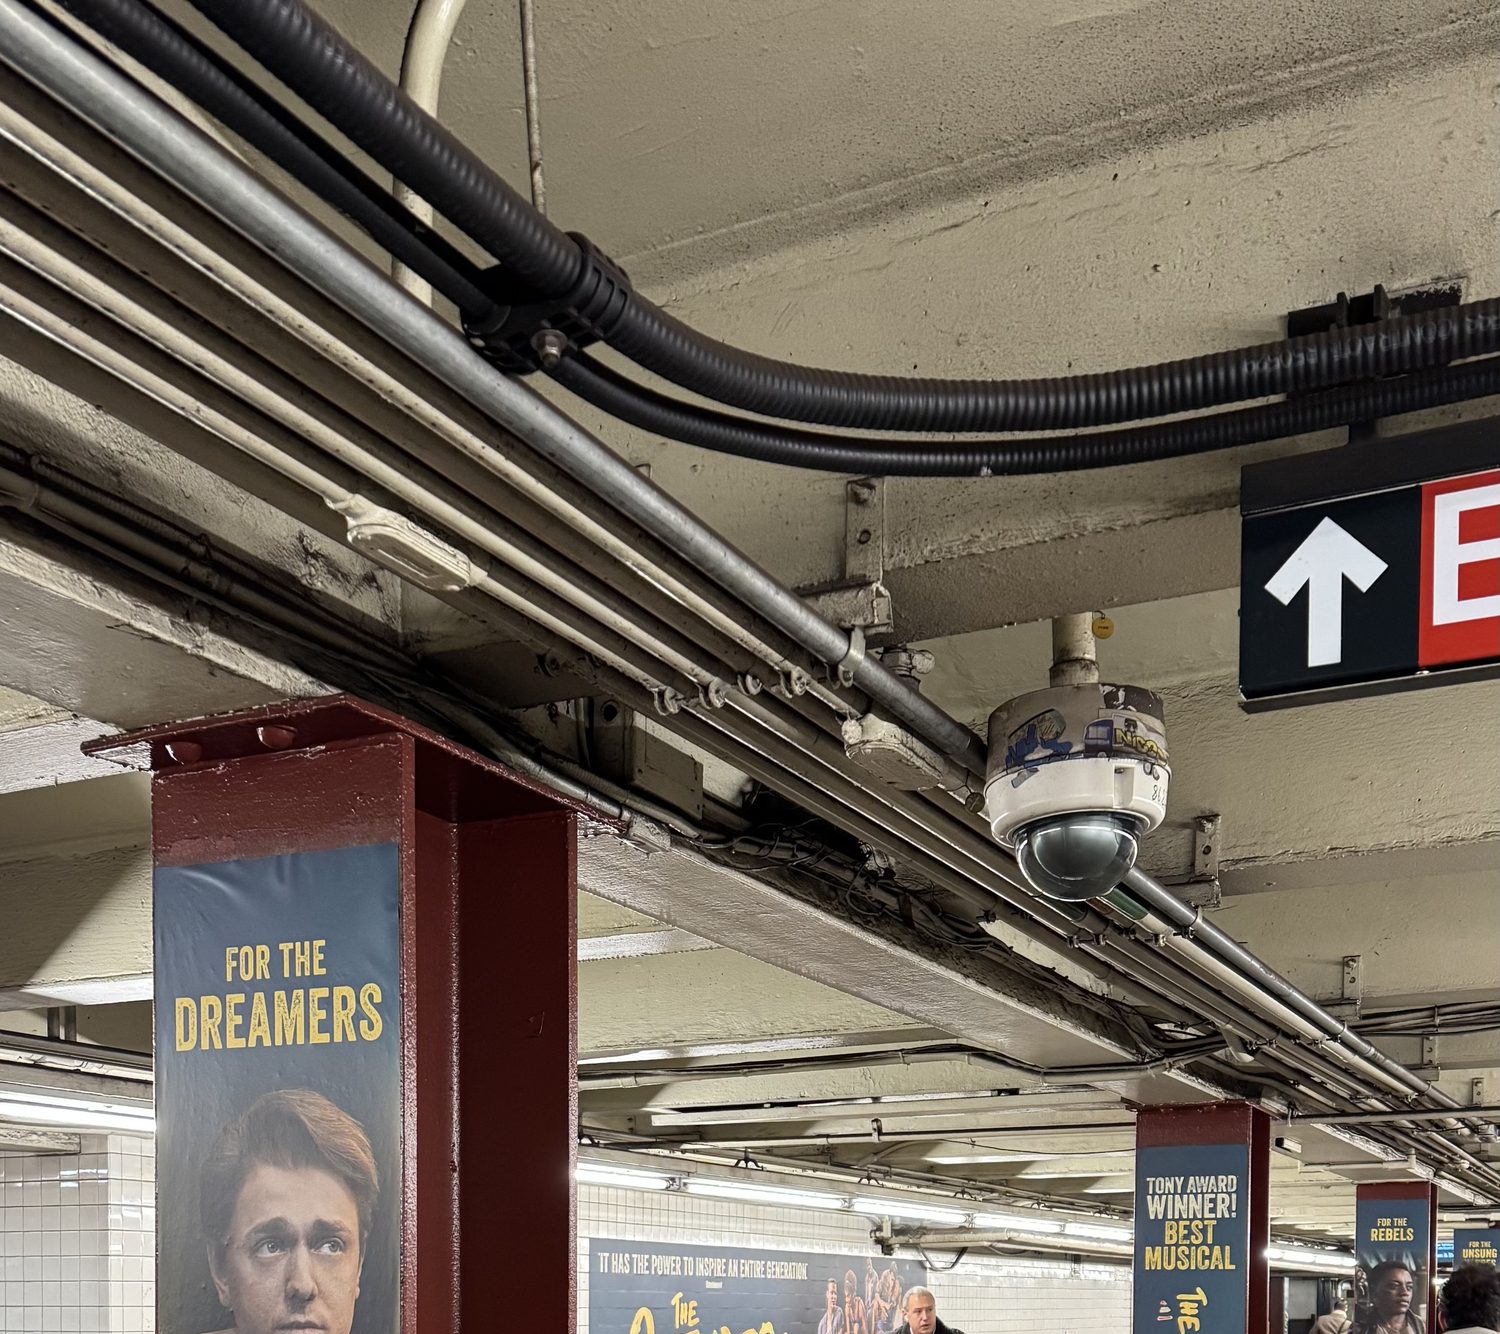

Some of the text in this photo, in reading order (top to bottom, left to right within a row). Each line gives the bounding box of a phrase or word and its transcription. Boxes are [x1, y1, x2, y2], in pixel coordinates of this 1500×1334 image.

[225, 939, 327, 982] FOR THE
[175, 983, 383, 1051] DREAMERS
[1146, 1175, 1237, 1195] TONY AWARD
[1146, 1193, 1237, 1219] WINNER!
[1164, 1220, 1217, 1245] BEST
[1370, 1227, 1414, 1242] REBELS
[1377, 1217, 1408, 1227] FOR THE
[611, 1253, 630, 1274] HAS
[632, 1254, 649, 1275] THE
[652, 1255, 682, 1276] POWER
[683, 1257, 694, 1276] TO
[696, 1257, 726, 1277] INSPIRE
[728, 1259, 738, 1278] AN
[740, 1259, 765, 1278] ENTIRE
[1145, 1245, 1236, 1270] MUSICAL
[1462, 1248, 1498, 1259] UNSUNG
[671, 1292, 700, 1329] THE
[1176, 1286, 1208, 1334] THE
